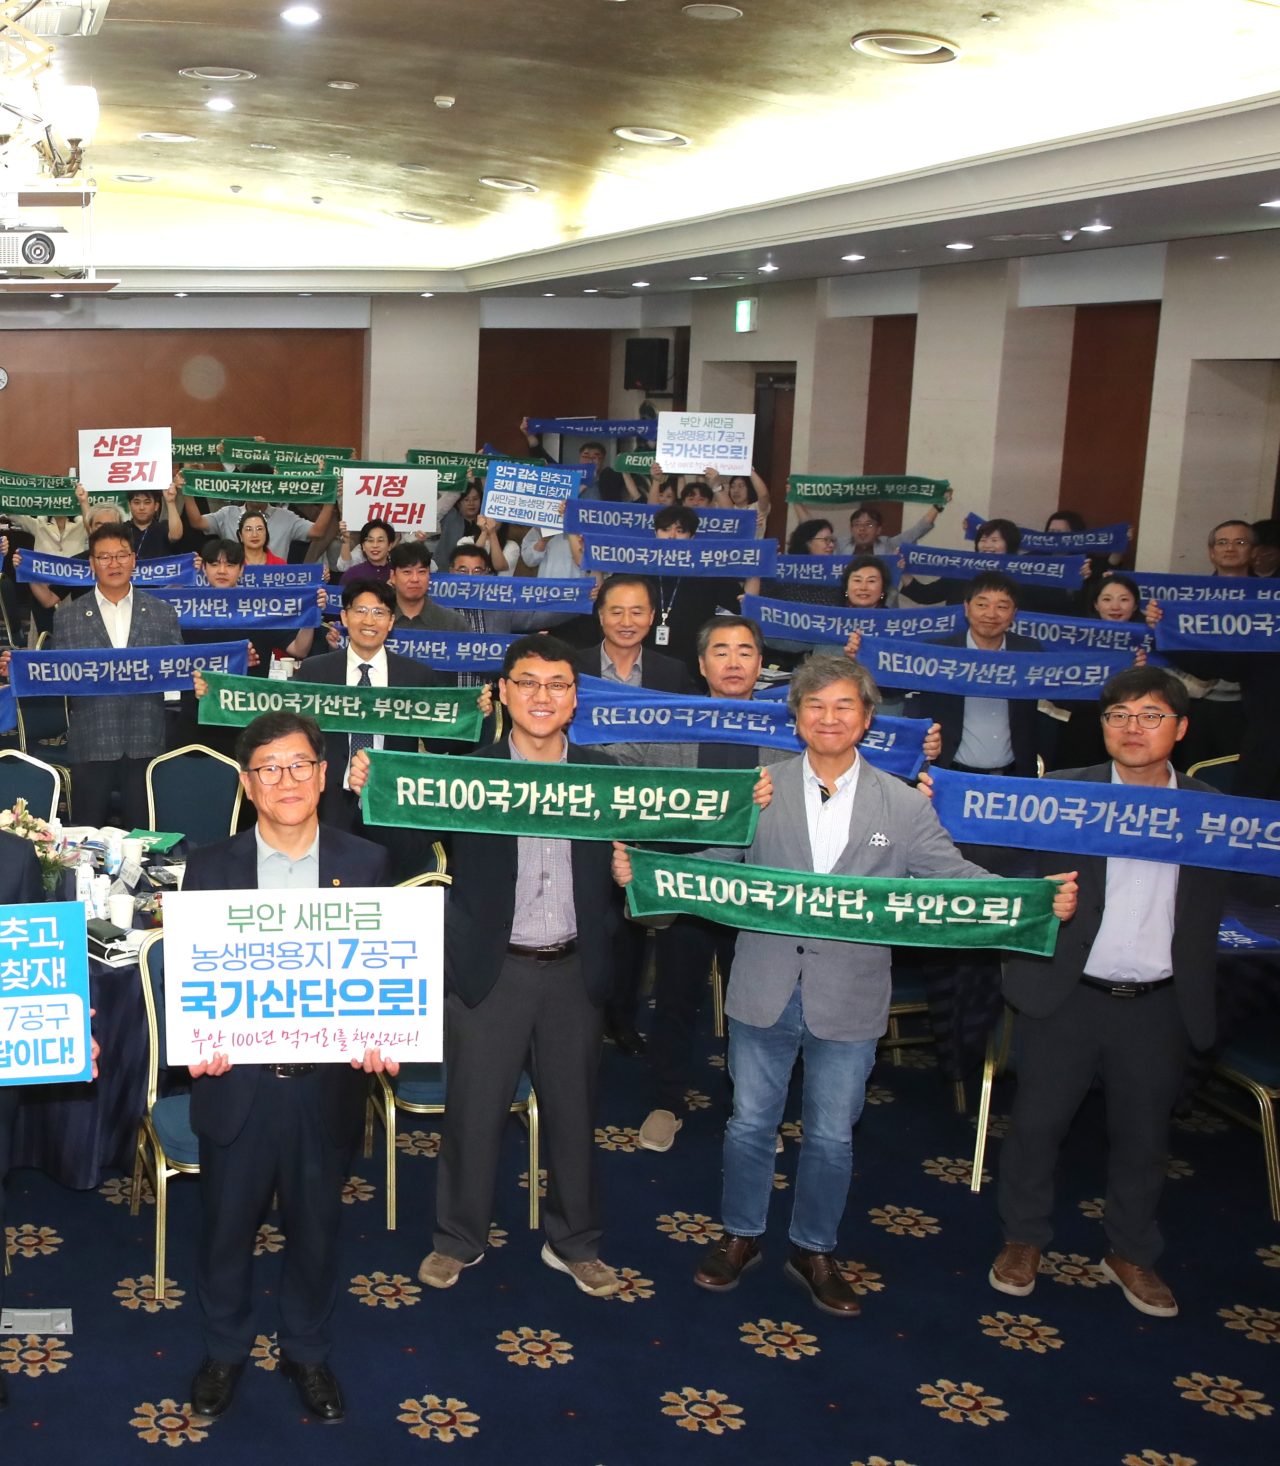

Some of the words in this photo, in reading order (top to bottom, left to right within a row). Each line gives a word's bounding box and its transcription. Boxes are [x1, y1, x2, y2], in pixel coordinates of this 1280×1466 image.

[680, 416, 701, 428] 부안
[703, 417, 734, 429] 새만금
[93, 434, 143, 458] 산업
[666, 429, 716, 442] 농생명용지
[661, 442, 748, 460] 국가산단으로!
[107, 461, 157, 484] 용지
[495, 465, 518, 478] 인구
[517, 467, 539, 480] 감소
[194, 478, 275, 496] RE100국가산단,
[277, 481, 325, 496] 부안으로!
[355, 475, 408, 498] 지정
[493, 478, 515, 492] 경제
[516, 480, 537, 494] 활력
[796, 483, 880, 497] RE100국가산단,
[885, 483, 935, 496] 부안으로!
[1, 495, 75, 510] RE100국가산단,
[487, 504, 508, 517] 산단
[508, 507, 537, 521] 전환이
[490, 493, 517, 506] 새만금
[519, 496, 545, 510] 농생명
[367, 502, 426, 525] 하라!
[696, 518, 740, 536] 안으로!
[591, 545, 695, 568] RE100국가산단,
[699, 549, 761, 568] 부안으로!
[262, 571, 312, 587] 부안으로!
[1006, 560, 1065, 578] 부안으로!
[427, 580, 517, 604] E100국가산단,
[520, 584, 580, 602] 부안으로!
[237, 597, 303, 618] 부안으로!
[760, 605, 879, 638] RE100국가산단,
[884, 614, 956, 637] 부안으로!
[27, 660, 153, 682] RE100국가산단,
[158, 655, 229, 679] 부안으로!
[878, 650, 1018, 686] RE100국가산단,
[1024, 665, 1110, 686] 부안으로!
[219, 687, 367, 720] RE100국가산단,
[373, 698, 459, 724] 부안으로!
[396, 776, 601, 821] RE100국가산단,
[609, 786, 731, 822] 부안으로!
[962, 789, 1184, 843] RE100국가산단,
[654, 868, 875, 924] RE100국가산단,
[884, 891, 1023, 927] 부안으로!
[227, 904, 287, 934] 부안
[294, 902, 383, 932] 새만금
[191, 940, 333, 972] 농생명용지
[337, 938, 419, 970] 7공구
[180, 978, 428, 1020] 국가산단으로!
[3, 1003, 71, 1032] 7공구
[191, 1028, 226, 1054] 부안
[231, 1030, 277, 1047] 100년
[281, 1028, 349, 1052] 먹거리를
[352, 1027, 420, 1048] 책임진다!
